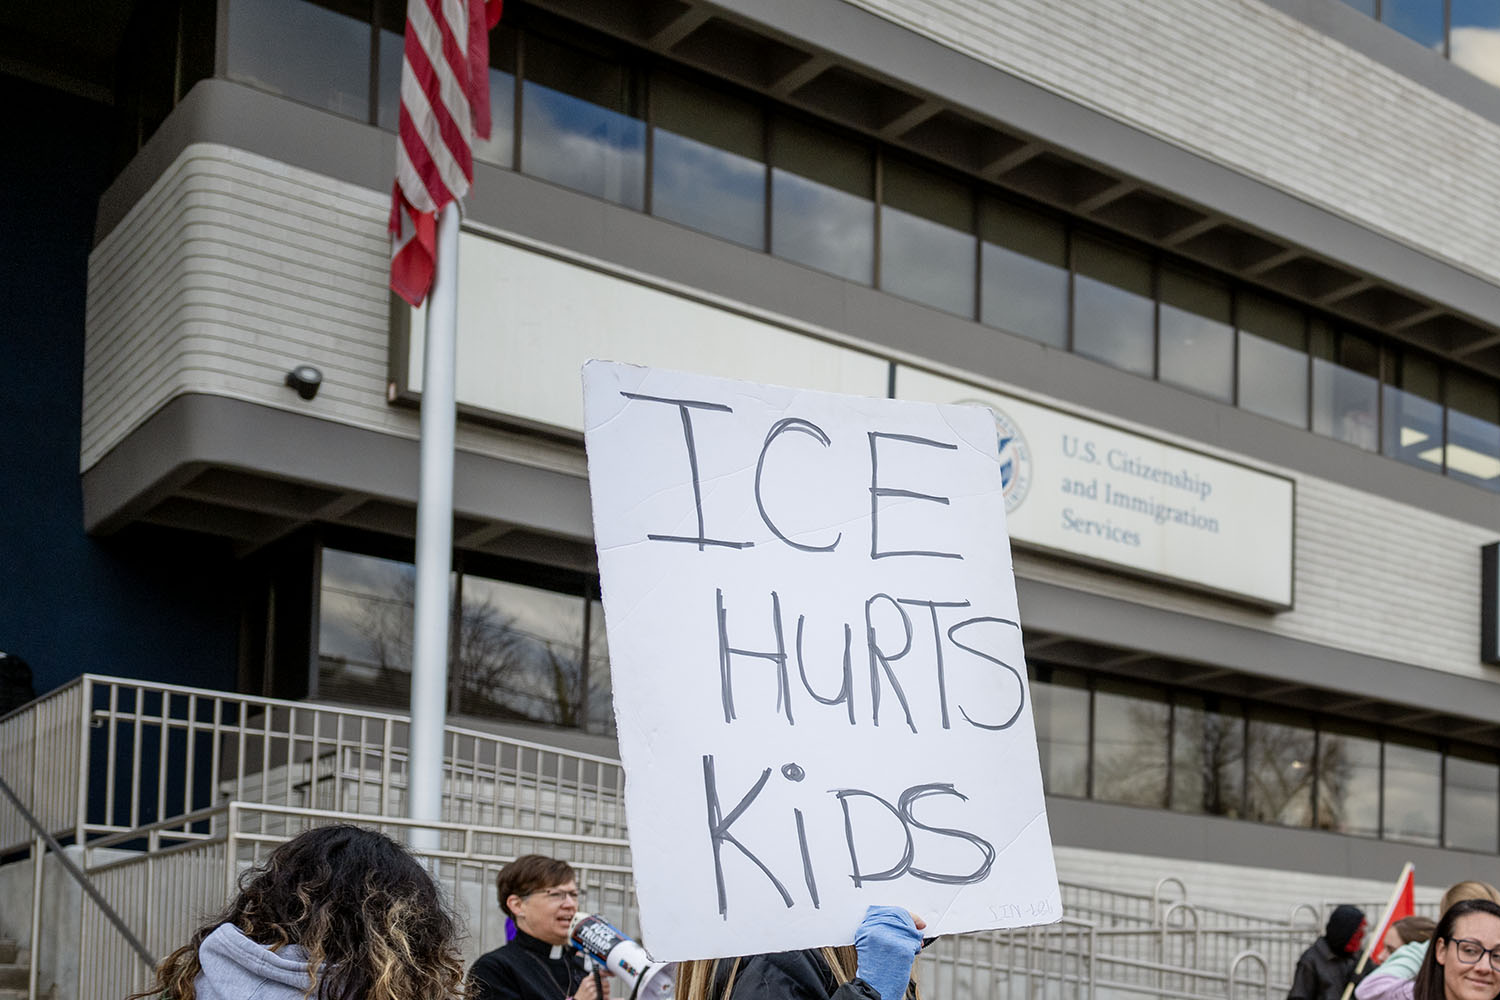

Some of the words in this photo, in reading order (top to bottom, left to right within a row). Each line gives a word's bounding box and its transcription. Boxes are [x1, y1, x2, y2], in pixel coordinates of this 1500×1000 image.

[620, 391, 964, 560] ICE
[1061, 434, 1100, 467] U.S.
[1107, 448, 1213, 502] Citizenship
[1061, 474, 1100, 502] and
[1105, 483, 1221, 535] Immigration
[1061, 508, 1142, 548] Services
[580, 925, 612, 952] TRUMP
